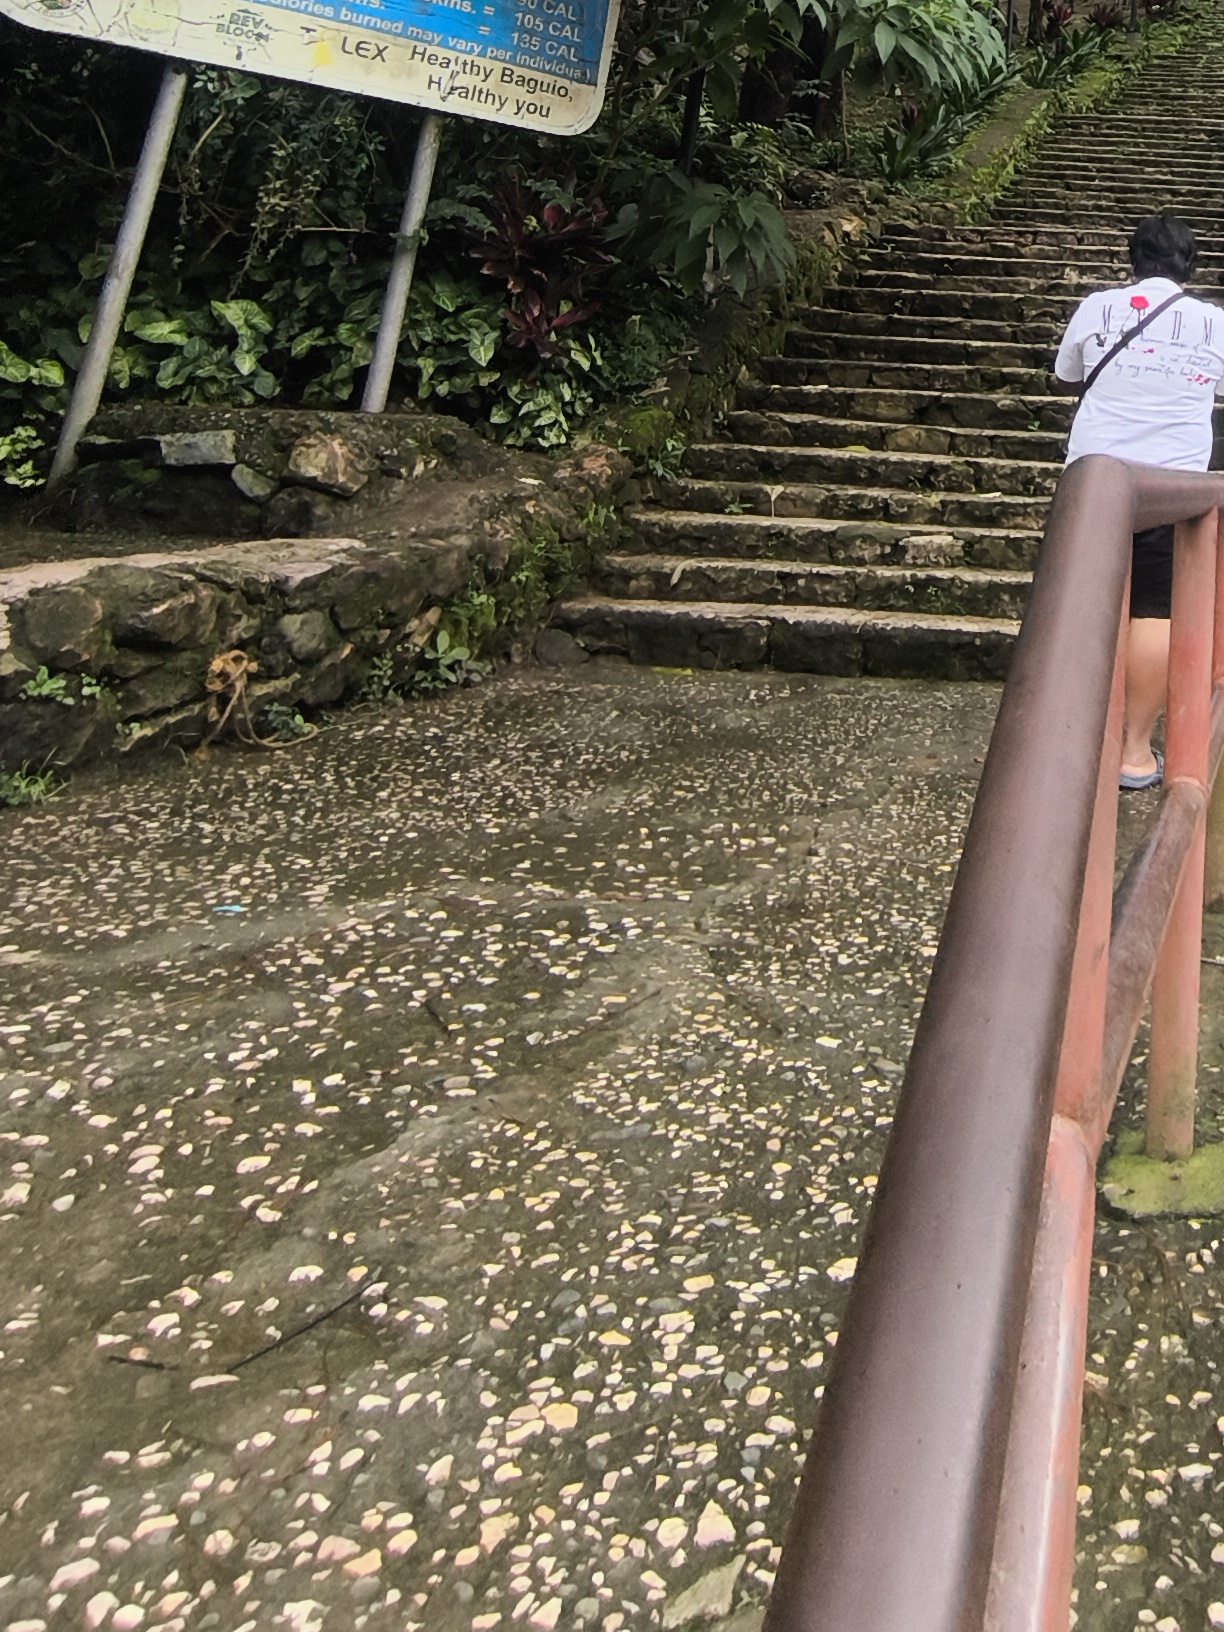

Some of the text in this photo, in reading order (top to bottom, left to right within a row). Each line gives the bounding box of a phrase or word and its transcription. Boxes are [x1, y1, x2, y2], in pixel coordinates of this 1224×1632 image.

[542, 0, 577, 21] CAL
[514, 12, 544, 32] 105
[549, 22, 582, 43] CAL
[340, 6, 404, 33] burned
[407, 25, 444, 46] may
[448, 36, 484, 56] vary
[486, 46, 513, 60] per
[517, 51, 591, 84] individua)
[511, 32, 541, 50] 135
[545, 41, 579, 63] CAL
[500, 65, 573, 102] Baguio,
[514, 98, 551, 118] you
